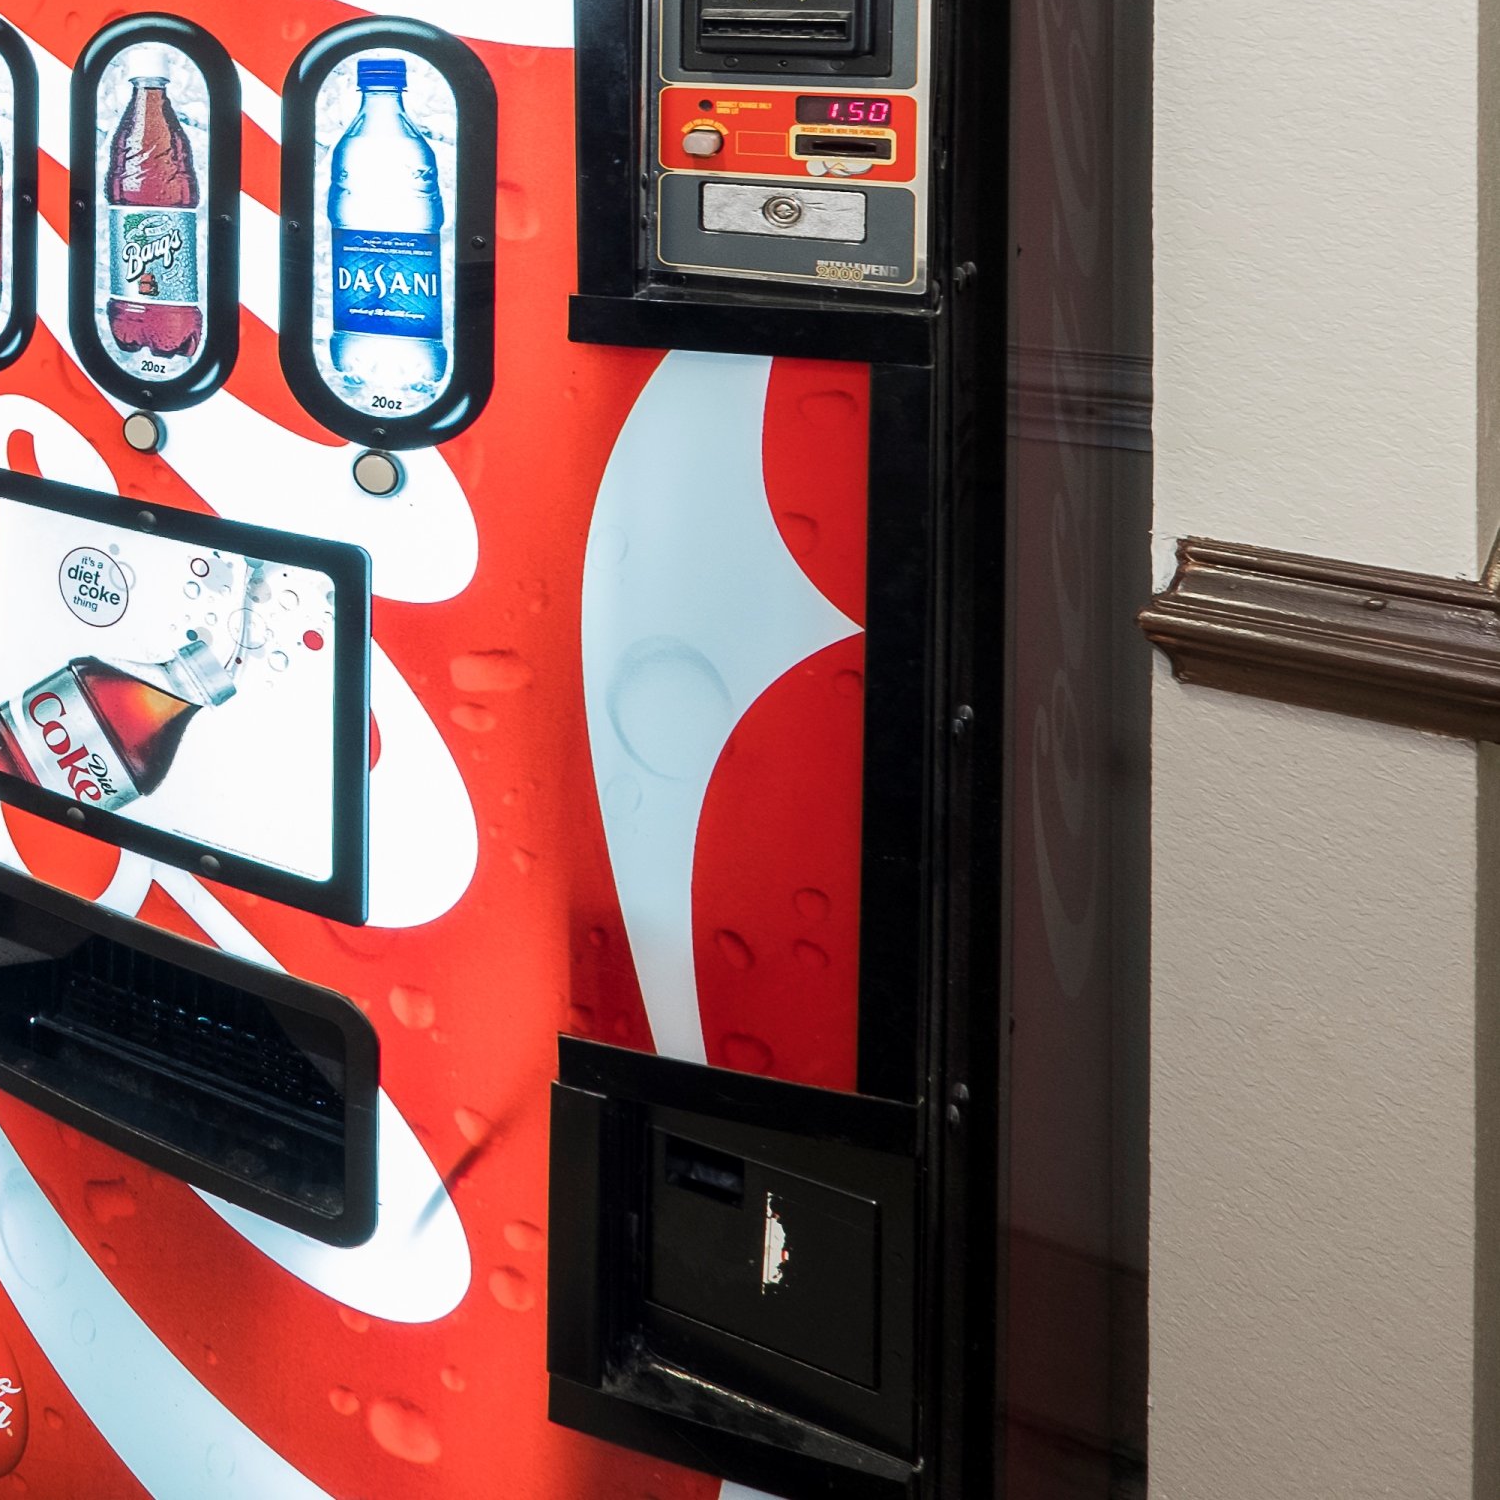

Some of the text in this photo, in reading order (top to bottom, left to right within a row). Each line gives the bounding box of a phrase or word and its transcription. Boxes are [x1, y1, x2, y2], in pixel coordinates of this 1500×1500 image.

[828, 102, 889, 122] 1.50
[122, 229, 183, 281] Barq's
[339, 263, 437, 299] DASANI
[816, 266, 864, 282] 2000
[140, 360, 166, 374] 20oz
[371, 395, 403, 411] 20oz
[81, 556, 95, 567] it's
[67, 564, 101, 587] diet
[73, 595, 99, 613] thing
[78, 583, 121, 605] coke
[28, 692, 103, 803] Coke
[88, 753, 117, 797] Diet
